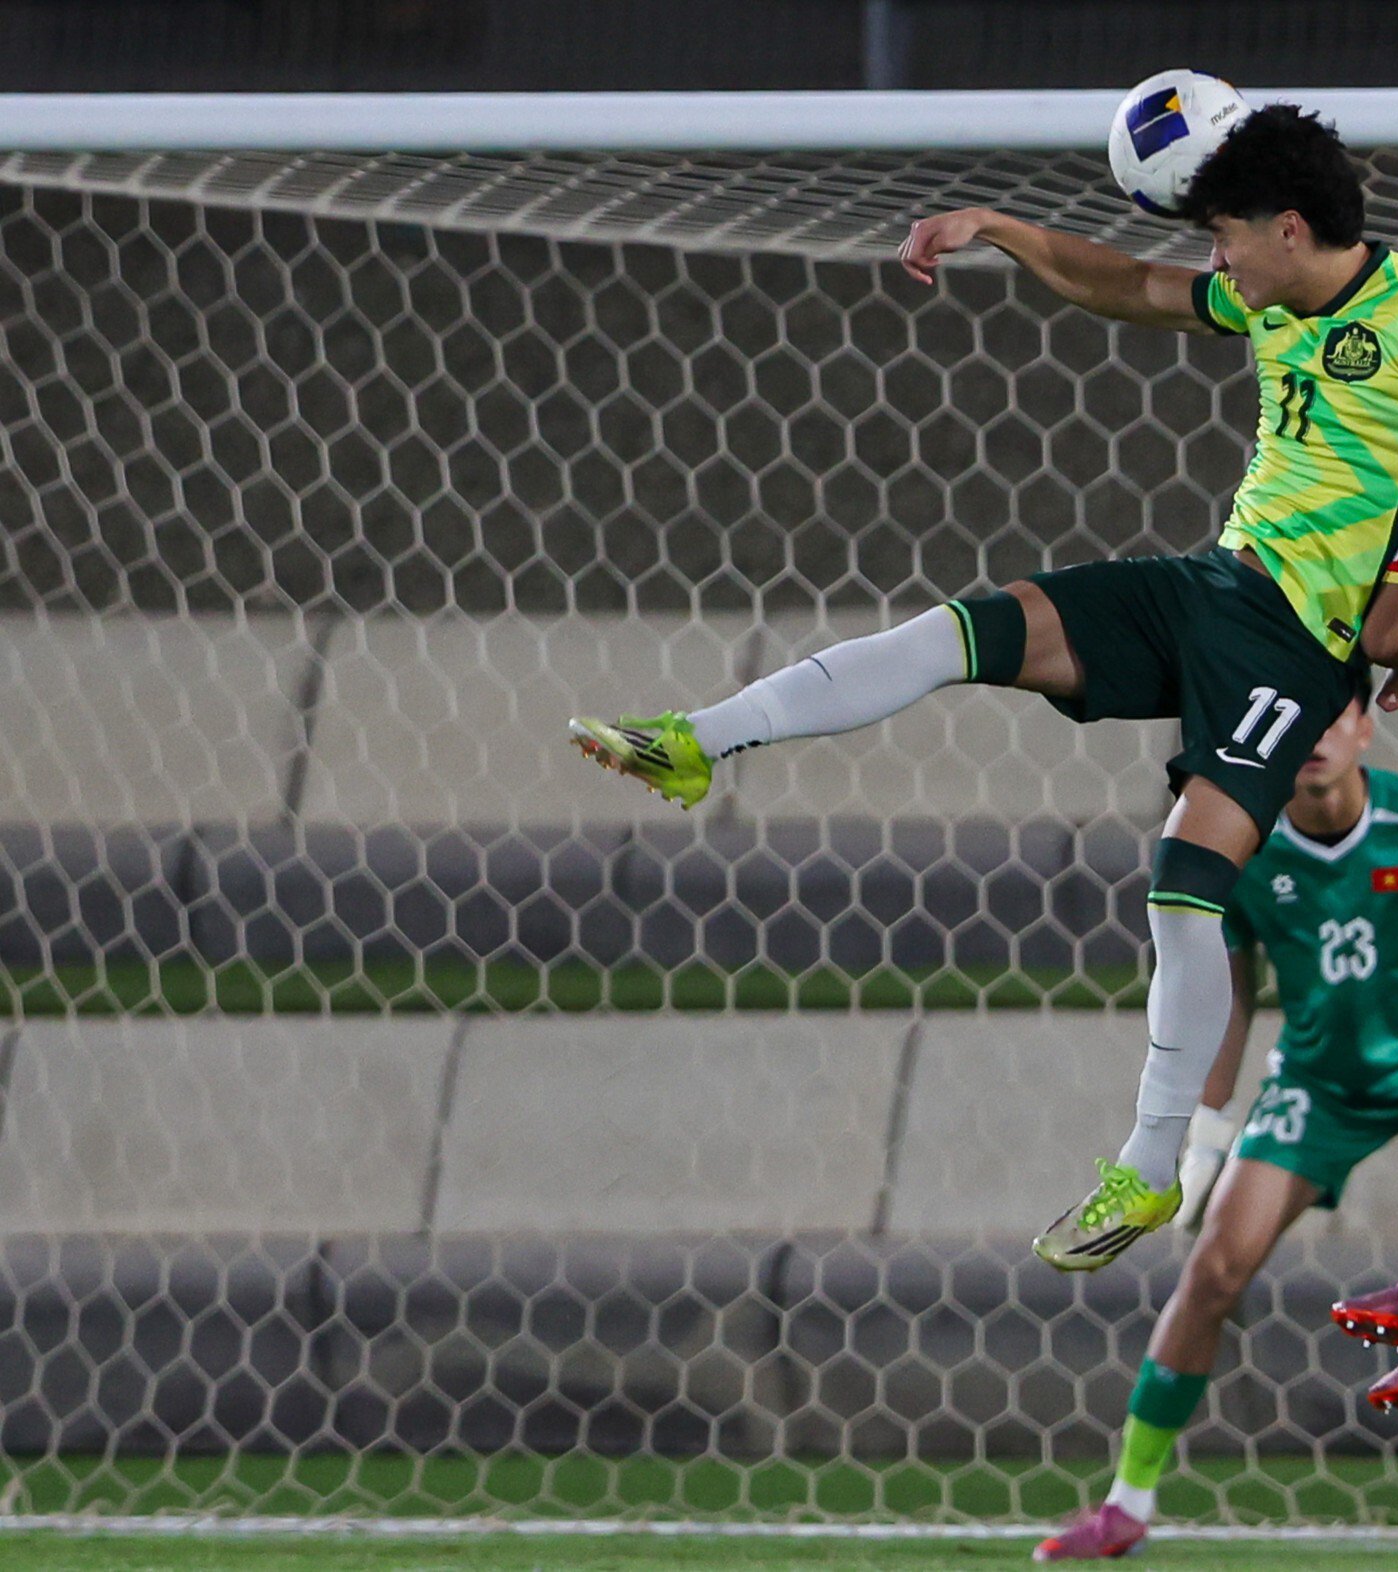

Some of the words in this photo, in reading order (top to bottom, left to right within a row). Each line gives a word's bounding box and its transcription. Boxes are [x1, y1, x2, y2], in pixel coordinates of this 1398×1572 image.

[1275, 371, 1315, 446] 11
[1231, 686, 1301, 760] 11
[1319, 916, 1378, 985] 23
[1251, 1083, 1311, 1144] 23
